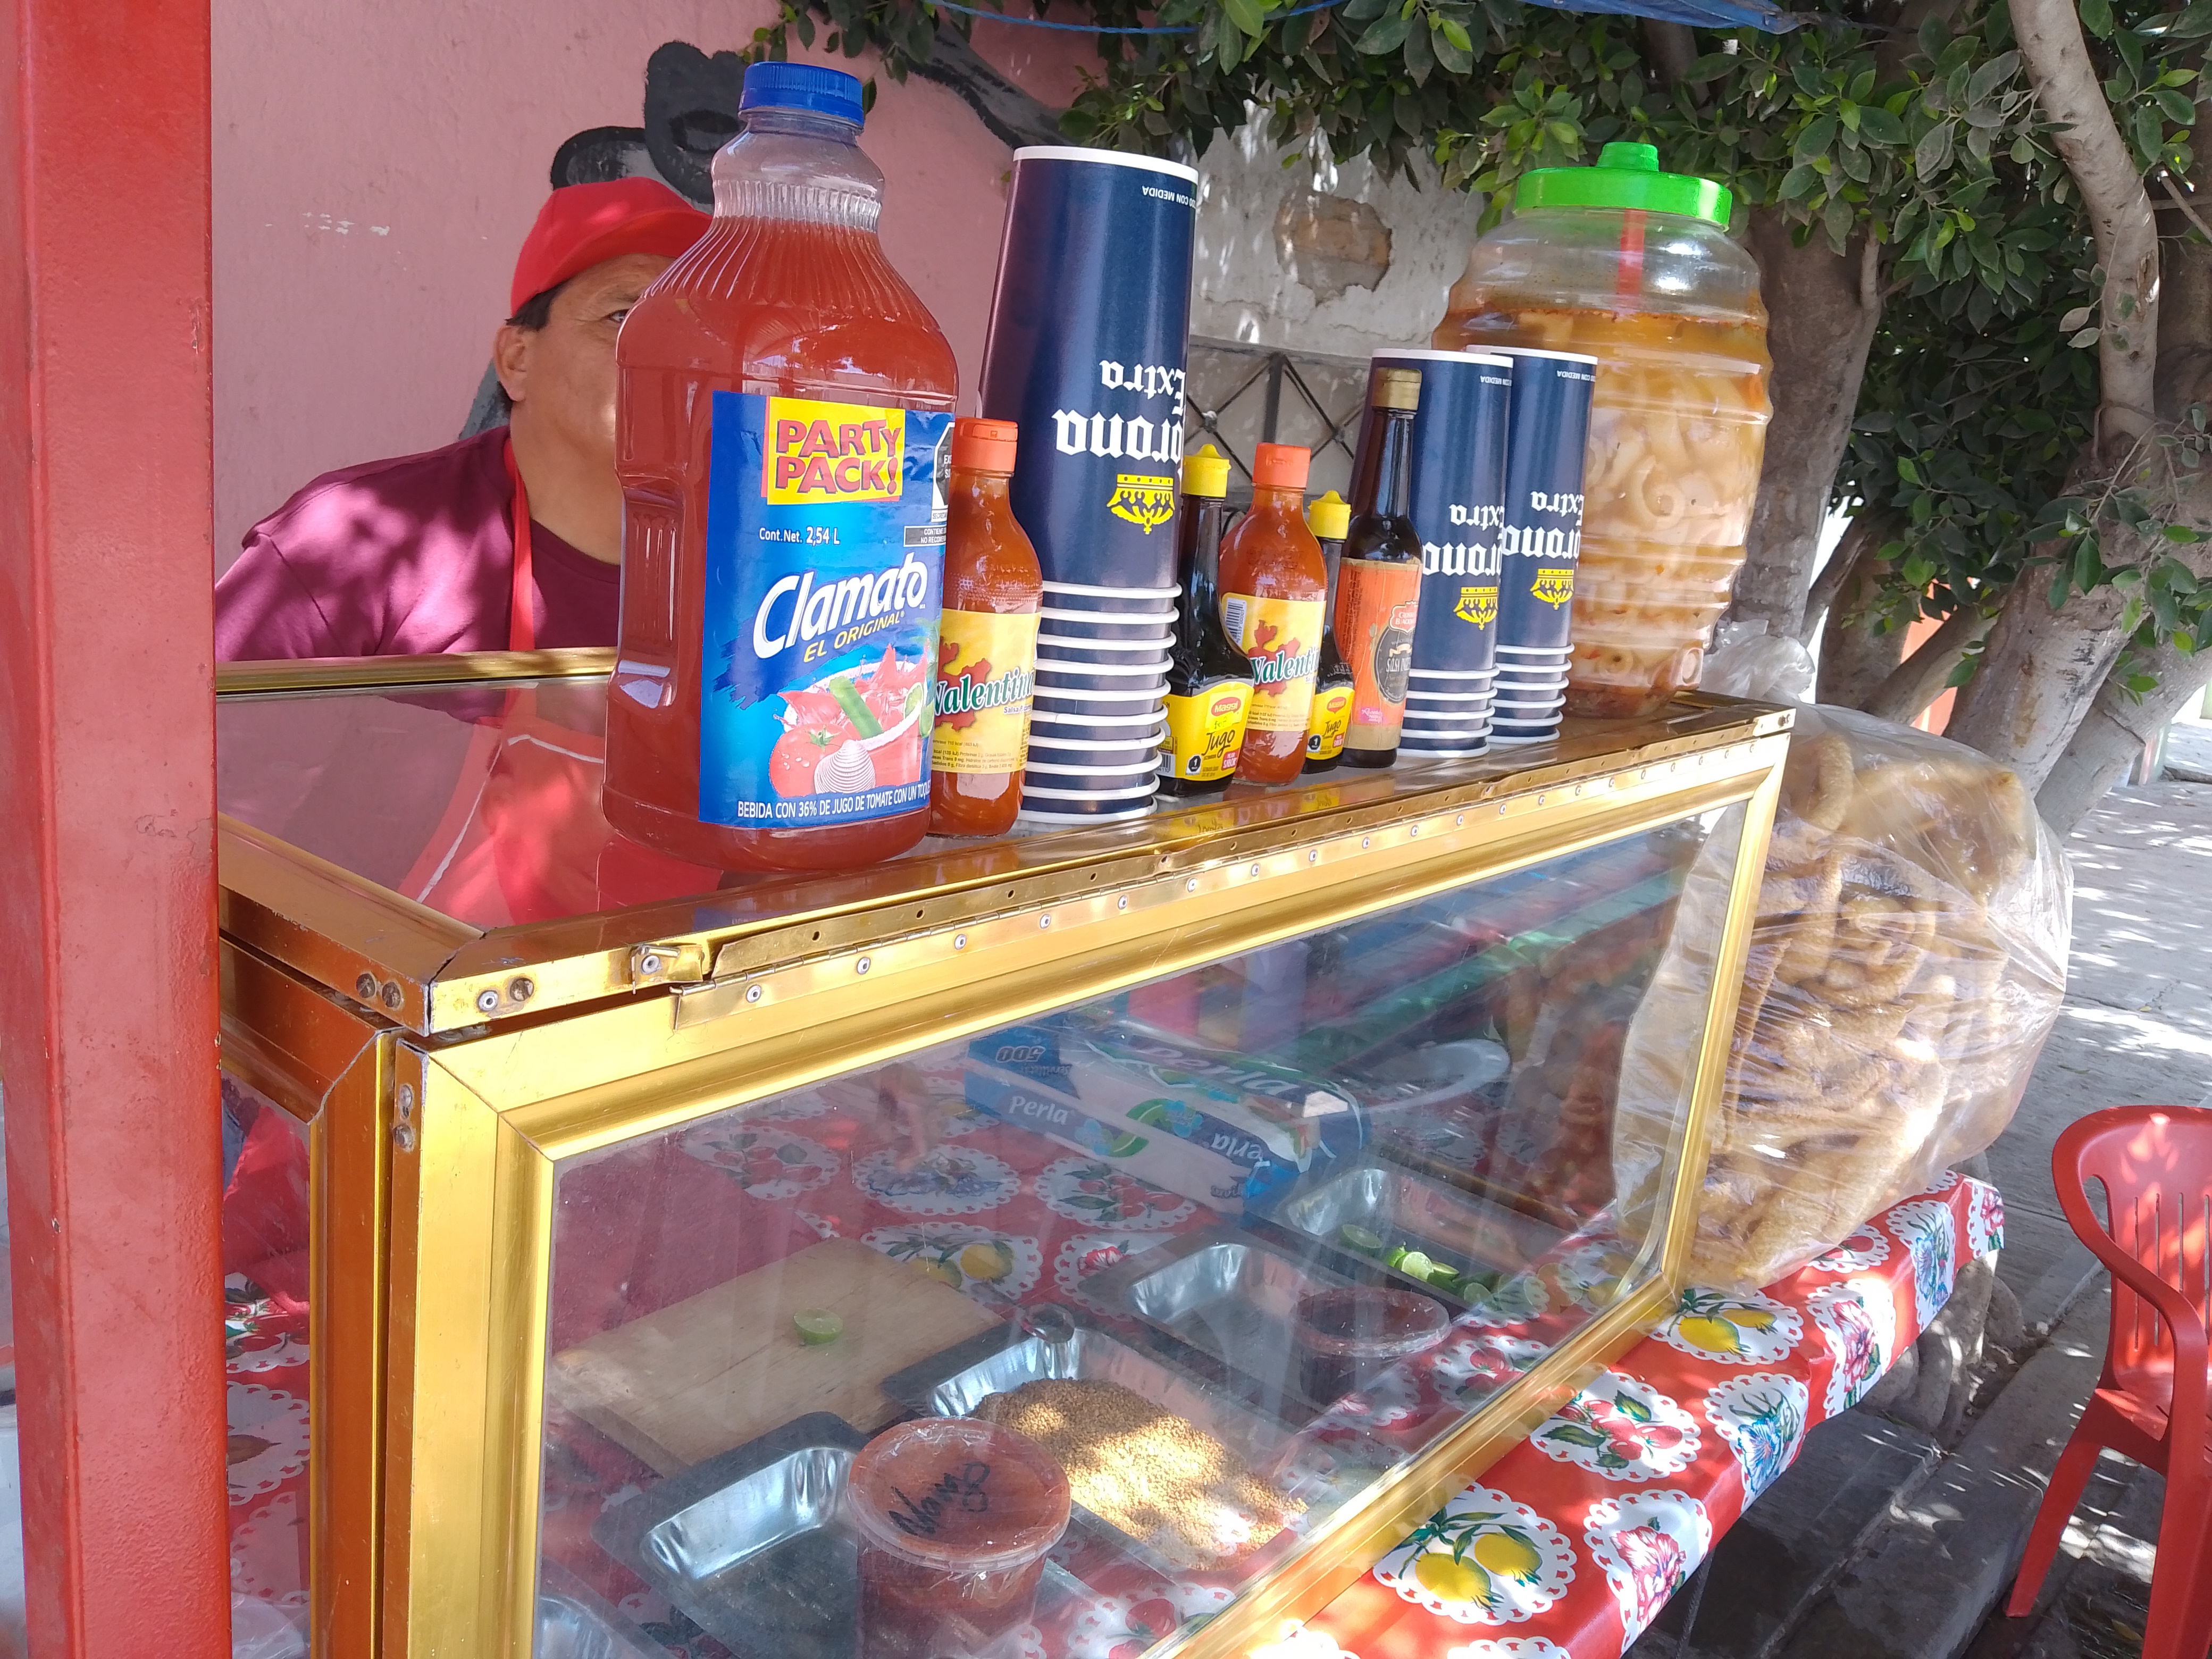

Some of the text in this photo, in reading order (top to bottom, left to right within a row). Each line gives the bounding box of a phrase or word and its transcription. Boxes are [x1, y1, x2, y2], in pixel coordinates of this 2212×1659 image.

[1142, 185, 1175, 202] MEDIDA
[1176, 193, 1188, 206] CON
[1099, 359, 1186, 416] Extra
[1480, 375, 1502, 385] MEDIDA
[1556, 370, 1581, 380] MEDIDA
[776, 418, 901, 460] PARTY
[1051, 408, 1184, 468] orona
[775, 455, 899, 495] PACK!
[1530, 491, 1585, 526] Extra
[806, 526, 830, 546] 2,54
[833, 527, 840, 544] L
[1502, 524, 1581, 559] orona
[753, 552, 928, 659] Clamato
[803, 612, 901, 663] EL ORIGINAL
[1004, 706, 1019, 714] Salsa
[1214, 701, 1239, 713] Maggi
[1322, 719, 1342, 738] Jugo
[1201, 729, 1236, 759] Jugo
[1223, 759, 1237, 769] SABOR
[738, 800, 773, 818] BEBIDA
[775, 801, 796, 818] CON
[799, 800, 817, 817] 36%
[819, 800, 831, 815] DE
[832, 798, 853, 814] JUGO
[855, 795, 865, 811] DE
[867, 791, 893, 809] TOMATE
[894, 788, 907, 805] CON
[908, 785, 917, 801] UN
[995, 1045, 1046, 1063] 500
[1008, 1095, 1069, 1126] Perla
